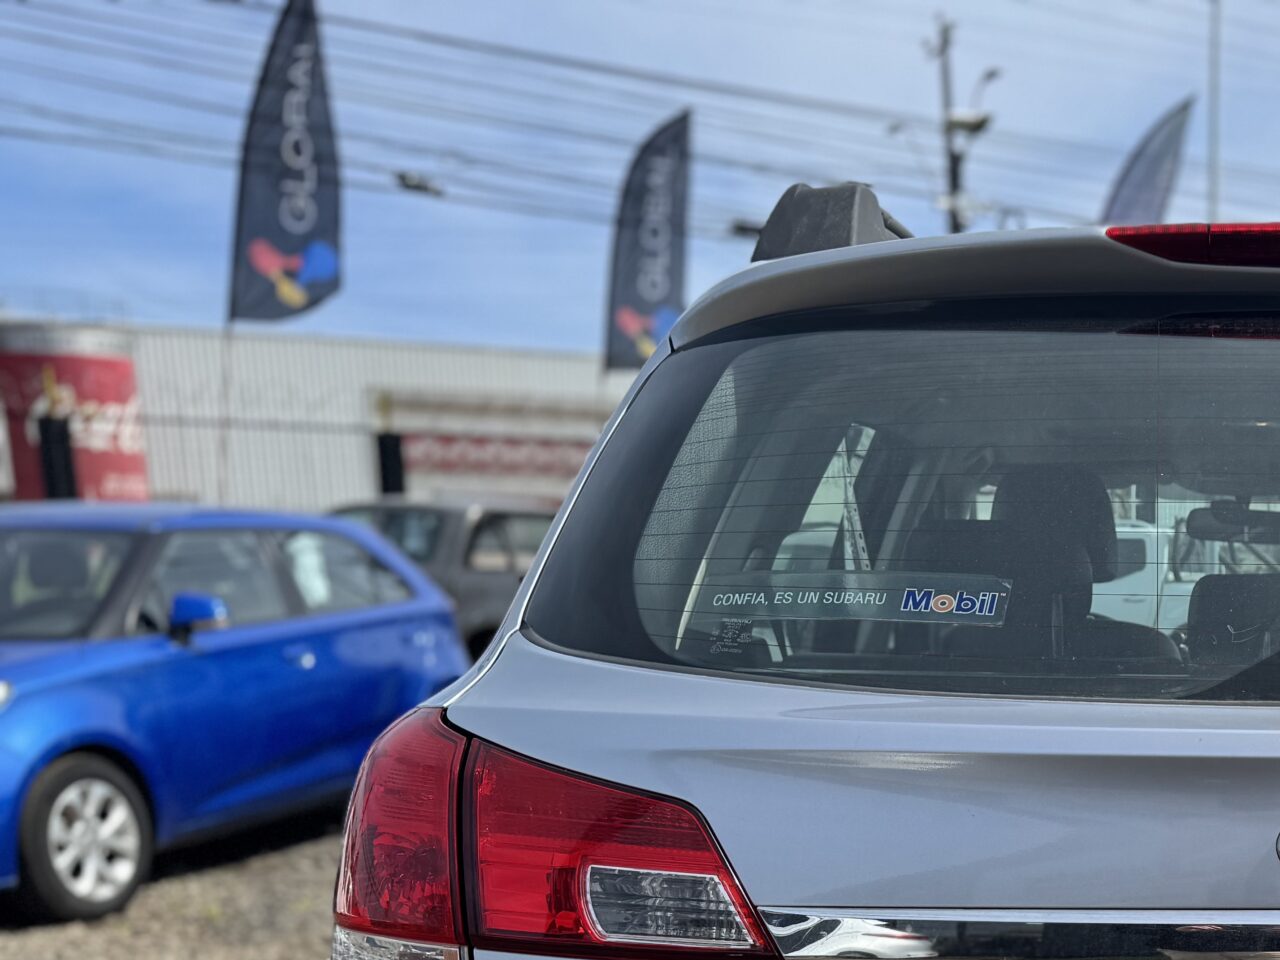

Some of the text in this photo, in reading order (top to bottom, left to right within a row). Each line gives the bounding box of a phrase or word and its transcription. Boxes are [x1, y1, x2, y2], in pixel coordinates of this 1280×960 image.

[712, 593, 768, 606] CONFIA,
[774, 592, 793, 604] ES
[797, 592, 819, 604] UN
[823, 592, 887, 605] SUBARU
[901, 588, 998, 616] Mobil
